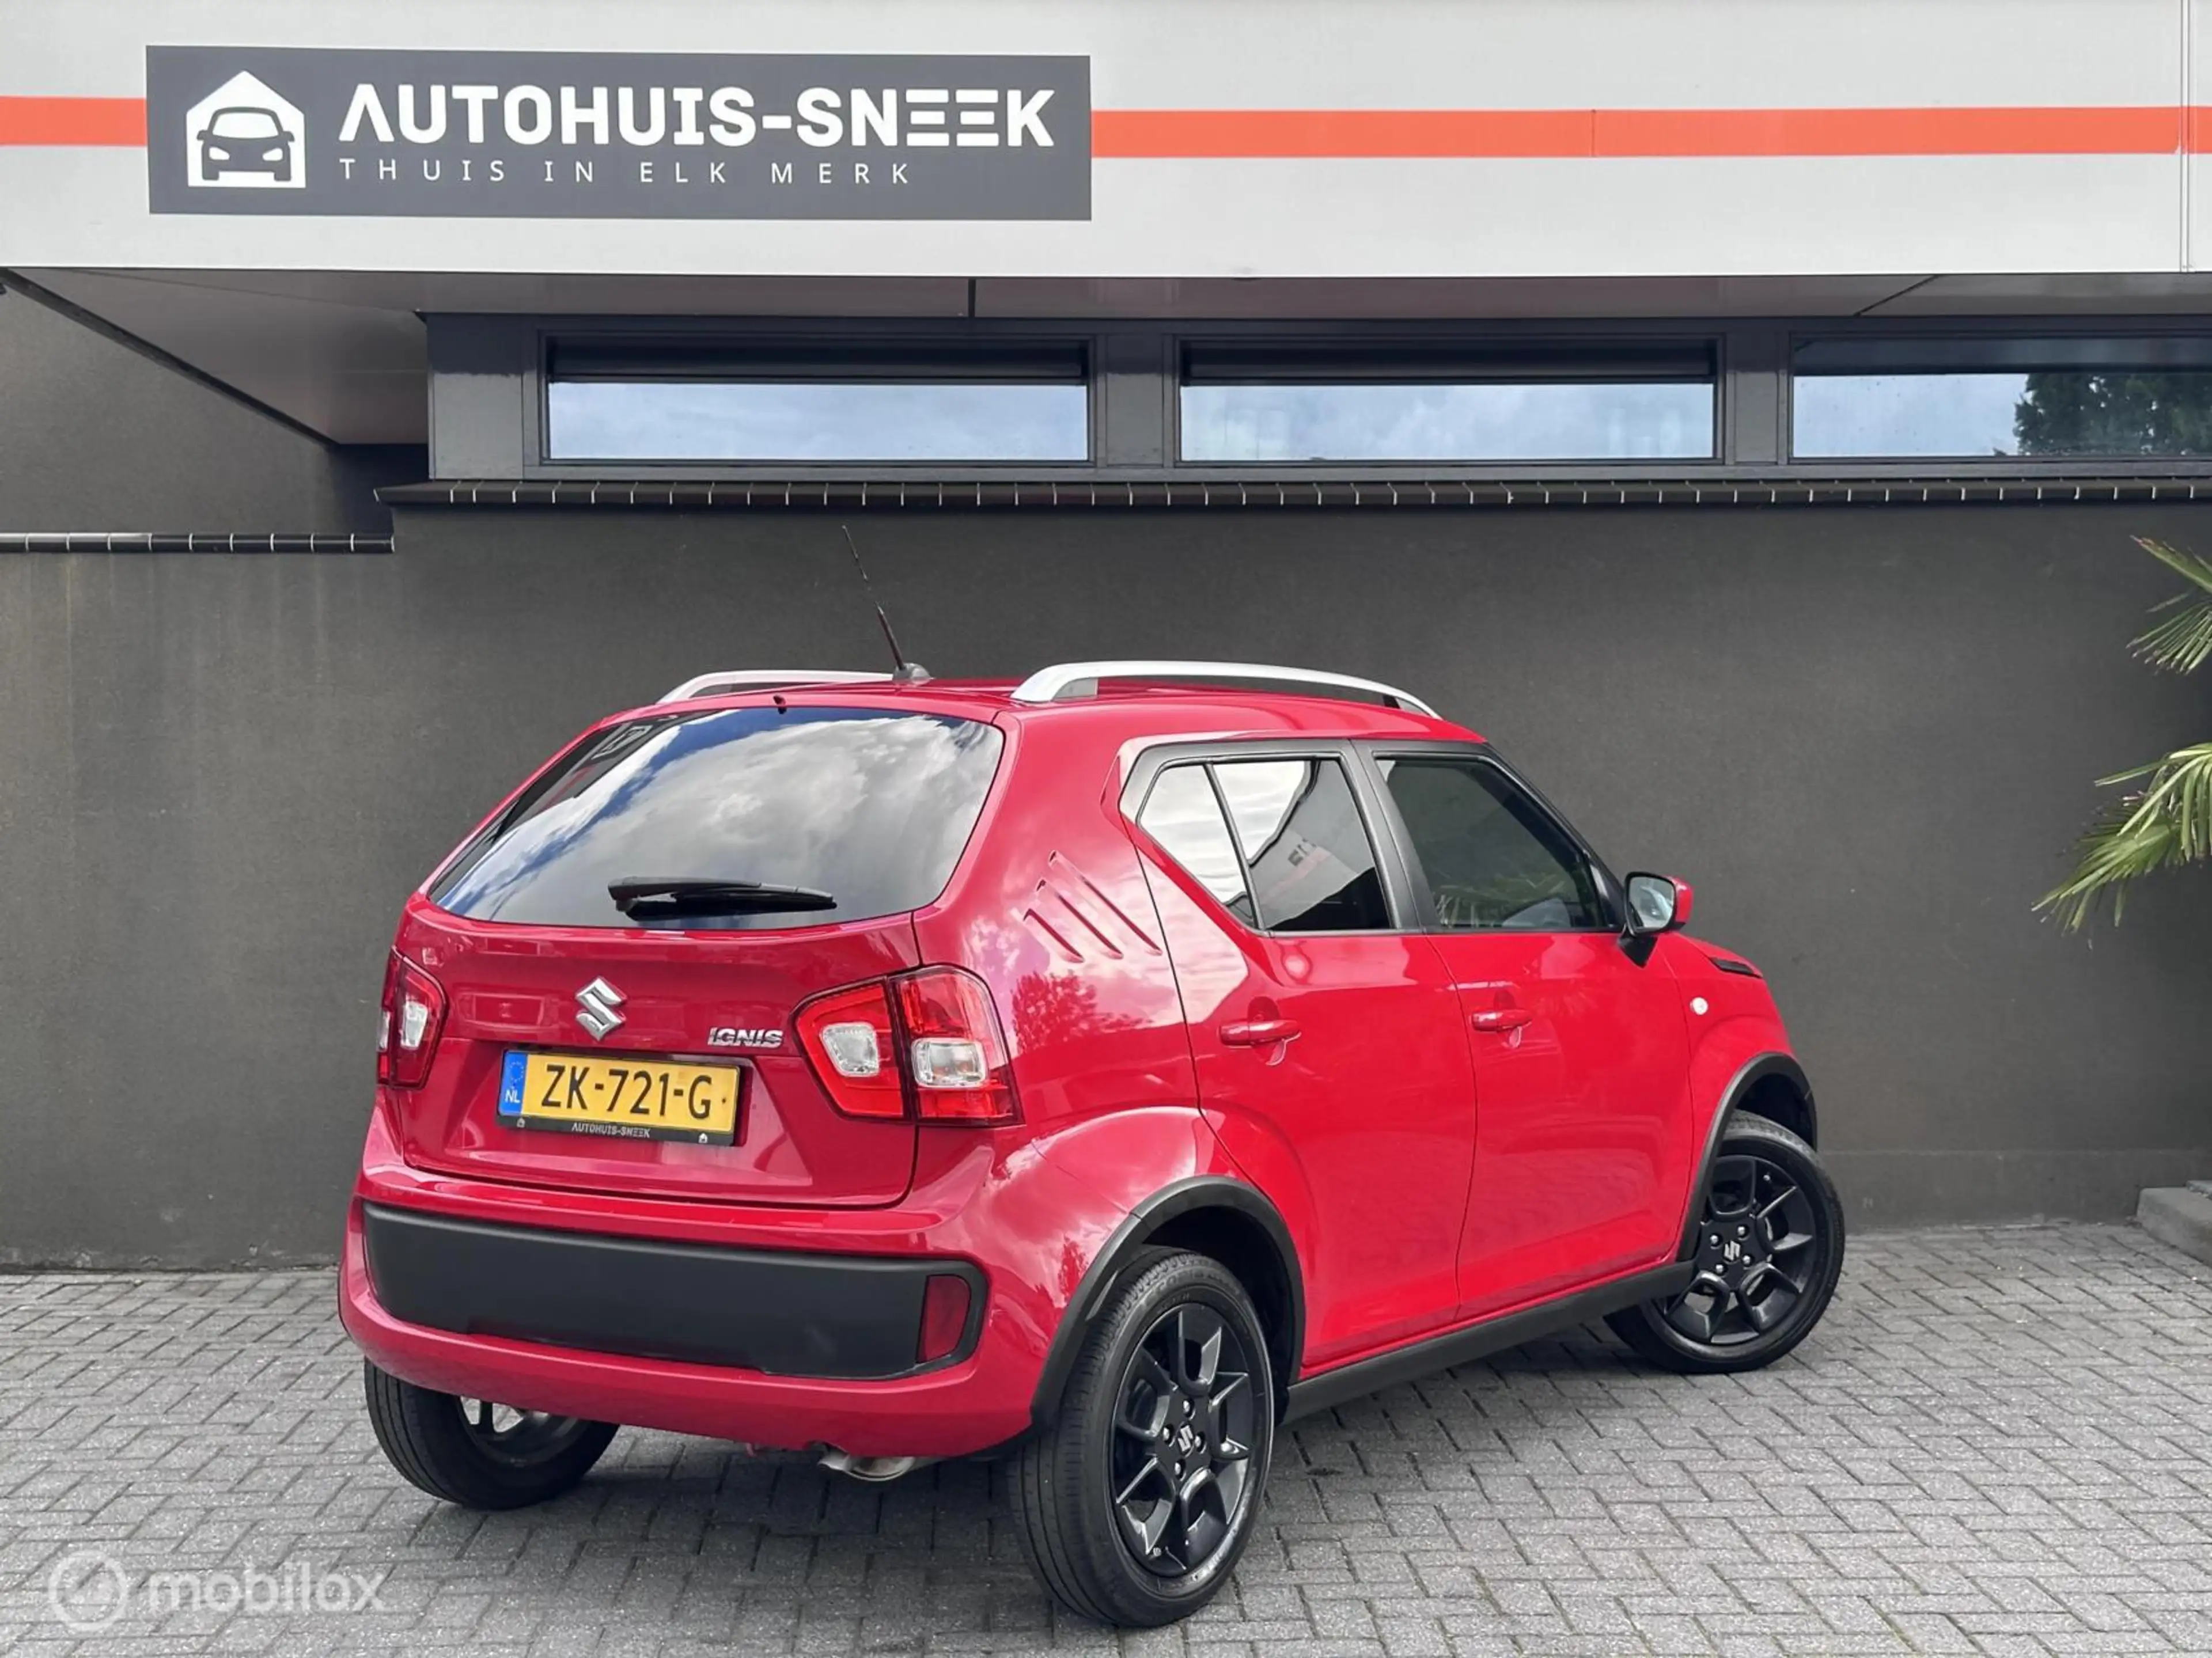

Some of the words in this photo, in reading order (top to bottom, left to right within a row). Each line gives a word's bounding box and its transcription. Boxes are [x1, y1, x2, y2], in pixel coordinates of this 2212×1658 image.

[339, 84, 1055, 146] AUTOHUIS-SNEEK
[339, 158, 505, 181] THUIS
[544, 161, 593, 182] IN
[641, 161, 725, 183] ELK
[771, 163, 908, 184] MERK
[707, 1027, 783, 1048] IGNIS
[505, 1090, 520, 1103] NL
[541, 1064, 713, 1120] ZK-721-G
[571, 1122, 651, 1139] AUTOHUIS-SNEEK
